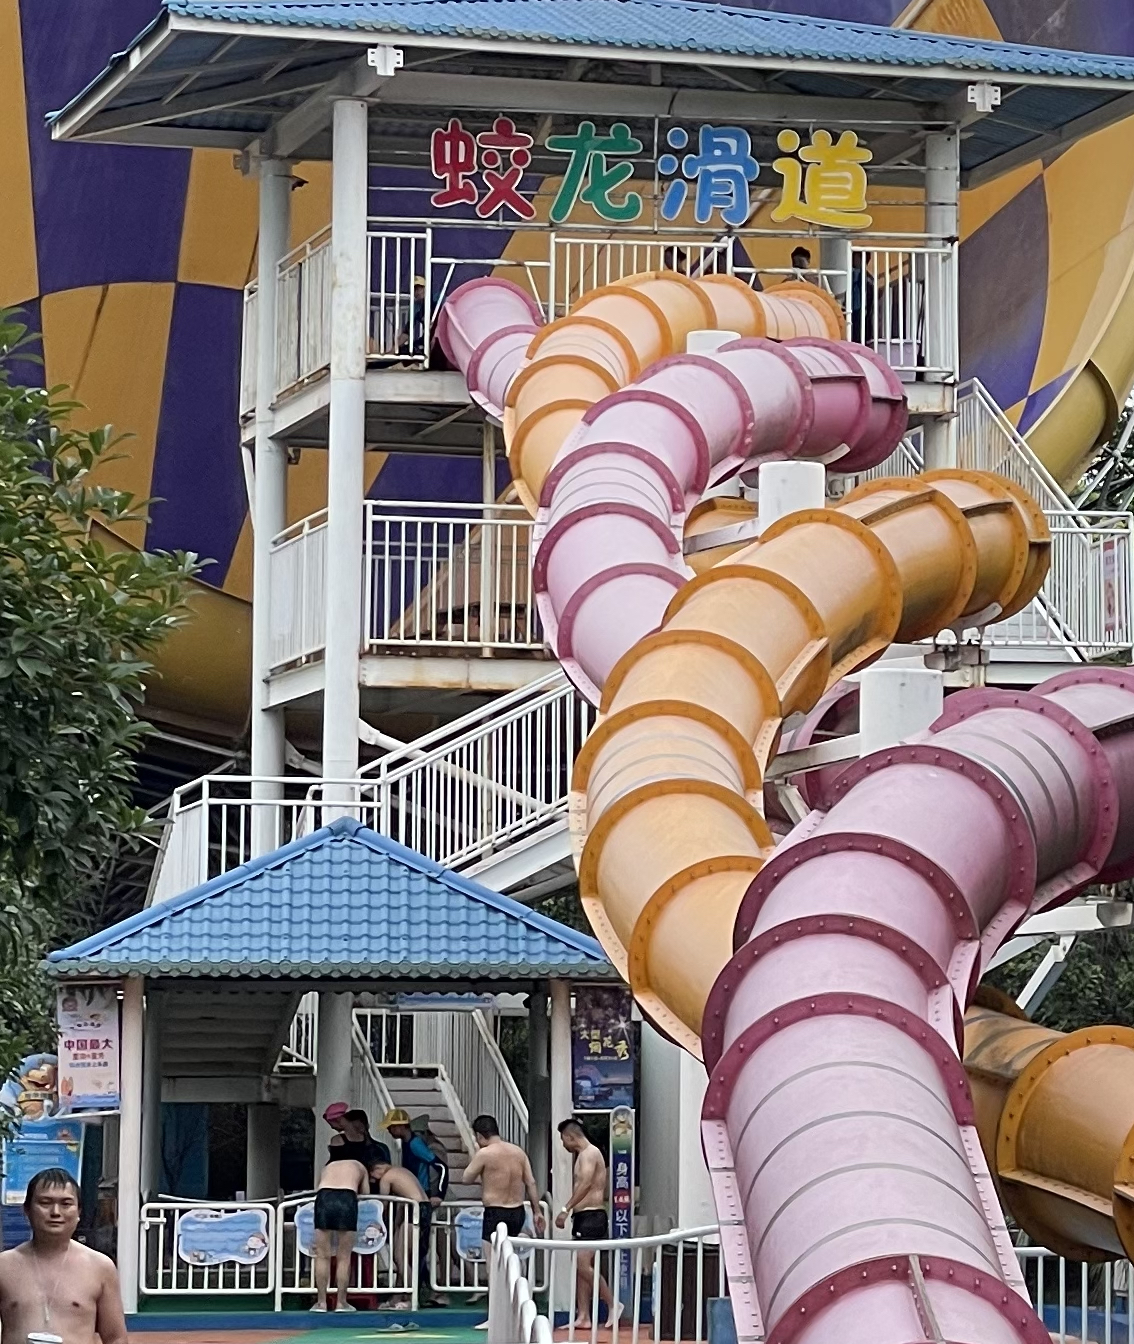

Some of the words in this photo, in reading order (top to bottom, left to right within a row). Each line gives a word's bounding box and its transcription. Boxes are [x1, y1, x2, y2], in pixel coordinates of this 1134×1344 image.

[430, 117, 874, 228] 蛟龙滑道
[64, 1038, 113, 1051] 中国最大
